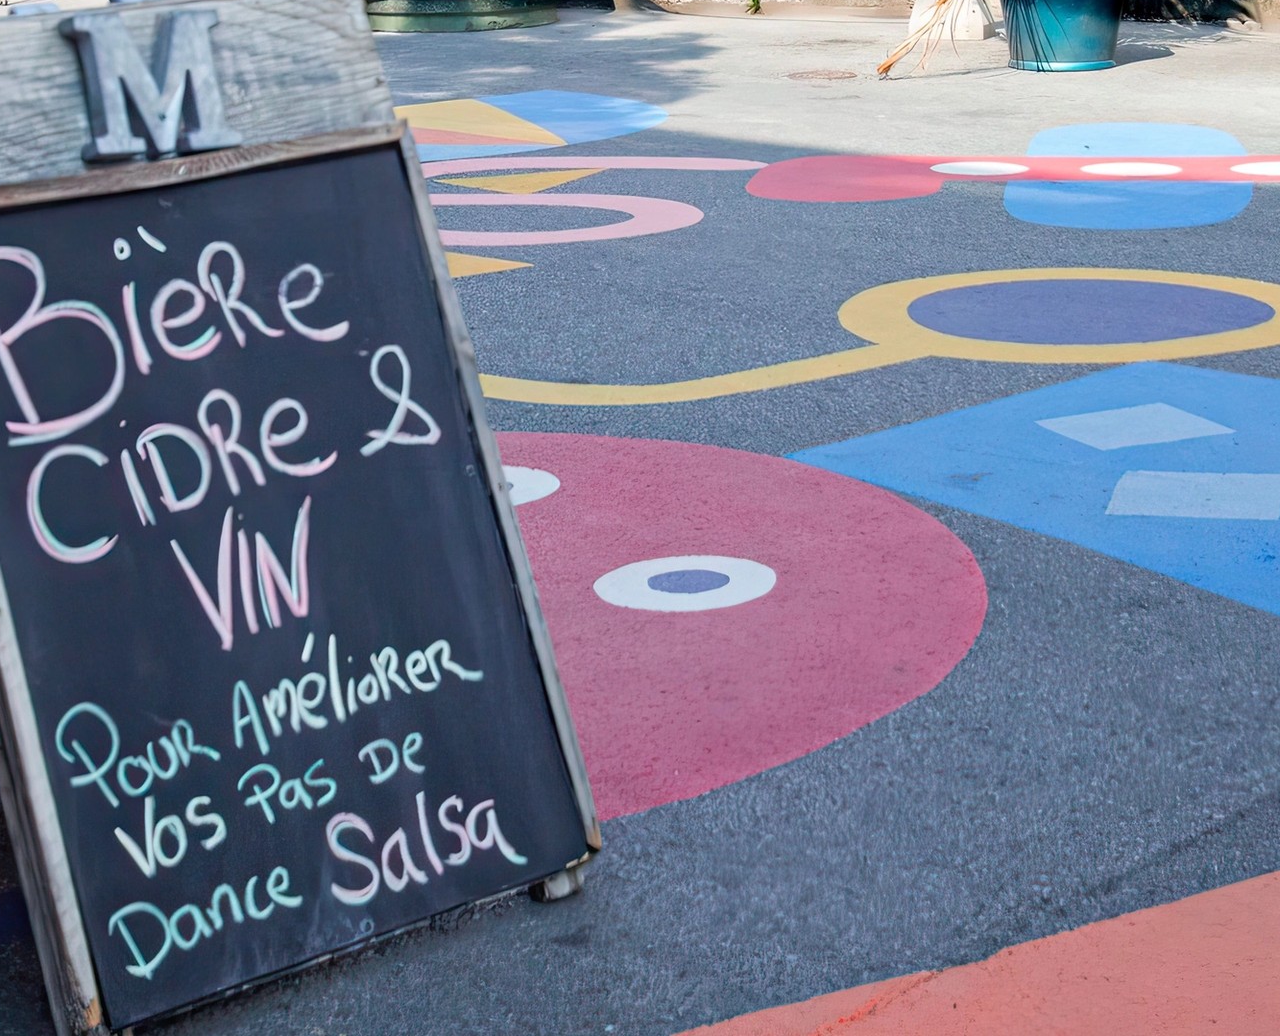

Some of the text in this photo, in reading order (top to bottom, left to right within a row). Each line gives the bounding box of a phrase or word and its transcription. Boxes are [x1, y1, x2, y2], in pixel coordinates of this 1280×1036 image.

[62, 7, 242, 162] M
[359, 345, 442, 457] &
[108, 791, 528, 981] Dance Salsa
